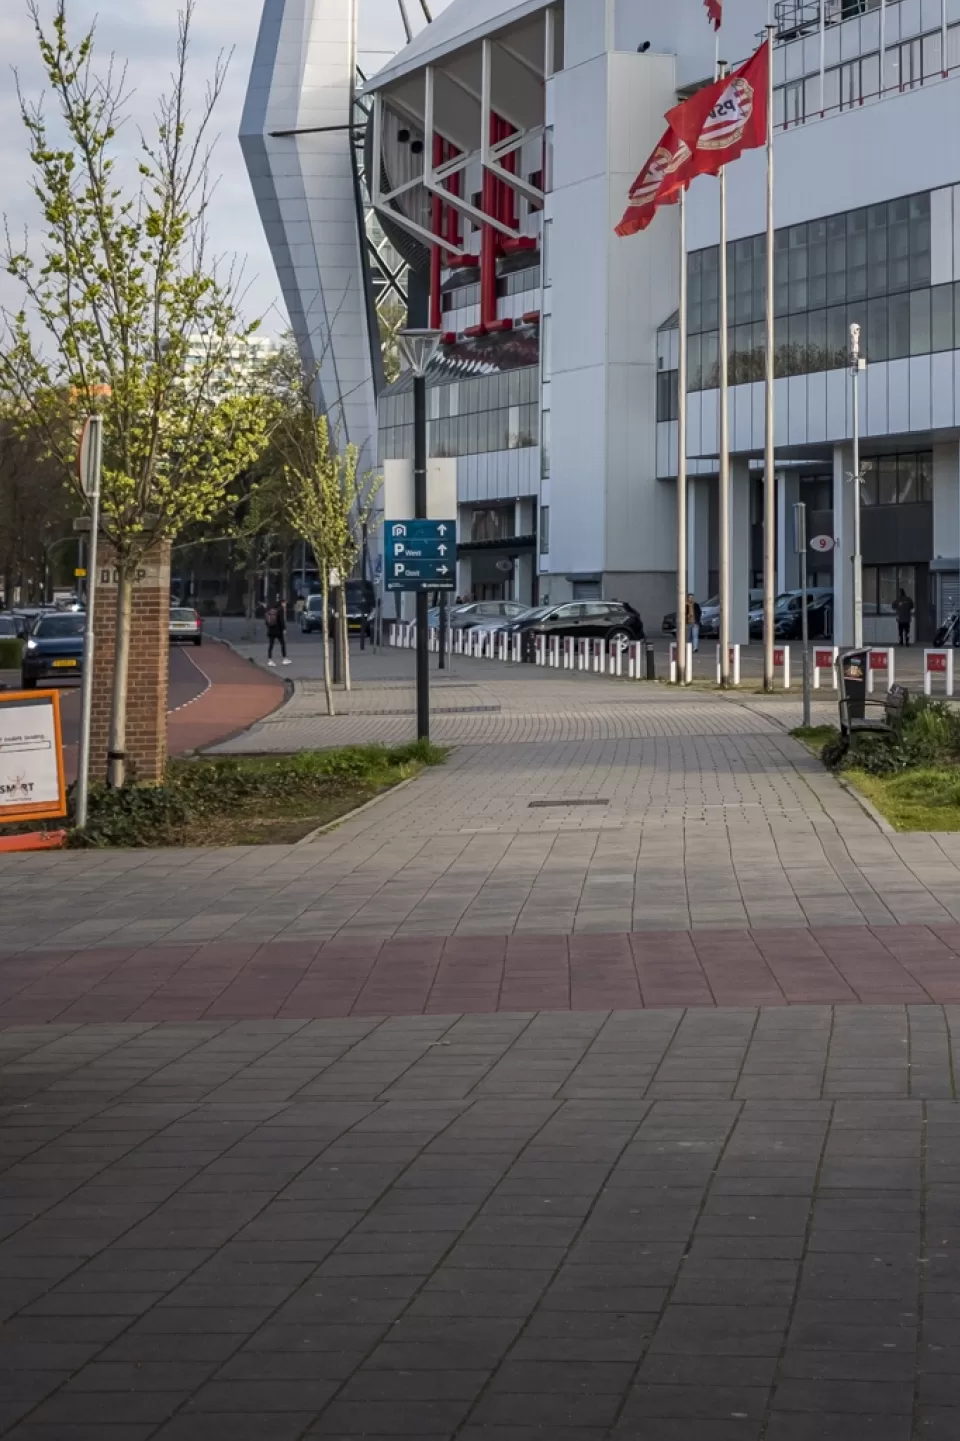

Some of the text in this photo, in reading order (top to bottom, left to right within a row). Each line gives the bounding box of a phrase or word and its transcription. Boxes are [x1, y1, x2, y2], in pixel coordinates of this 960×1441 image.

[394, 543, 404, 556] P
[819, 539, 826, 548] 9
[394, 563, 404, 576] P
[101, 569, 146, 584] DOP
